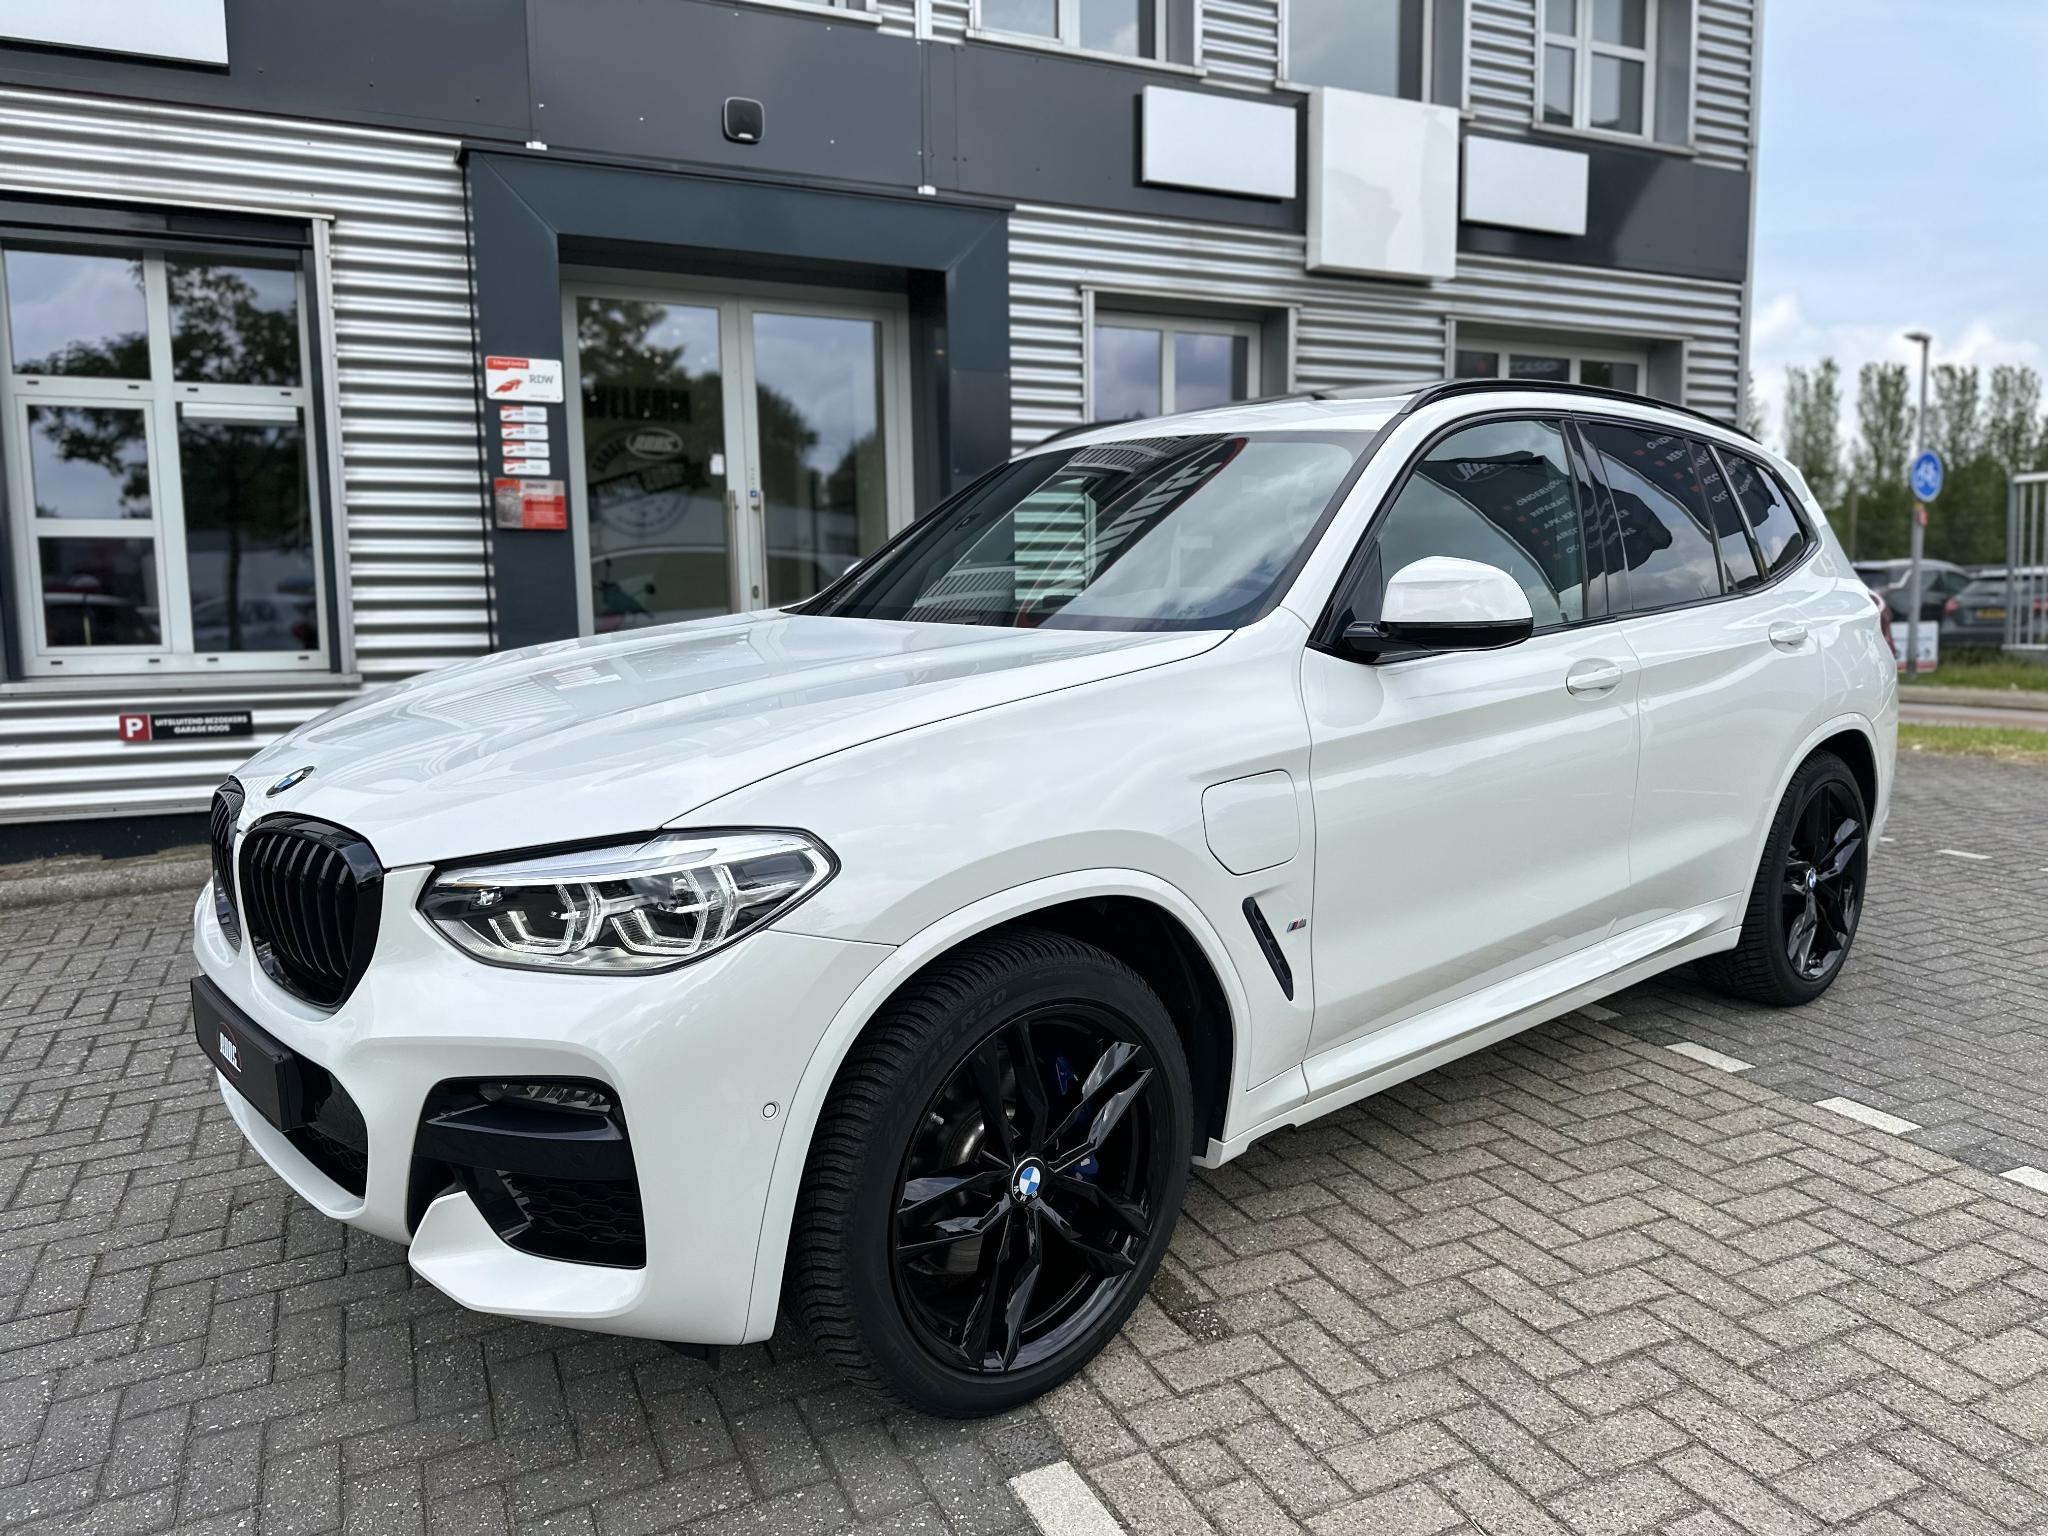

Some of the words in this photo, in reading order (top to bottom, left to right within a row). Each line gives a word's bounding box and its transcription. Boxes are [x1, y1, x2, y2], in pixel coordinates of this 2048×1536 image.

[529, 374, 554, 384] RDW
[154, 718, 204, 727] UITSLUITEND
[204, 715, 248, 725] BEZOEKERS
[125, 717, 144, 738] P
[173, 726, 208, 735] GARAGE
[207, 724, 231, 734] ROOS
